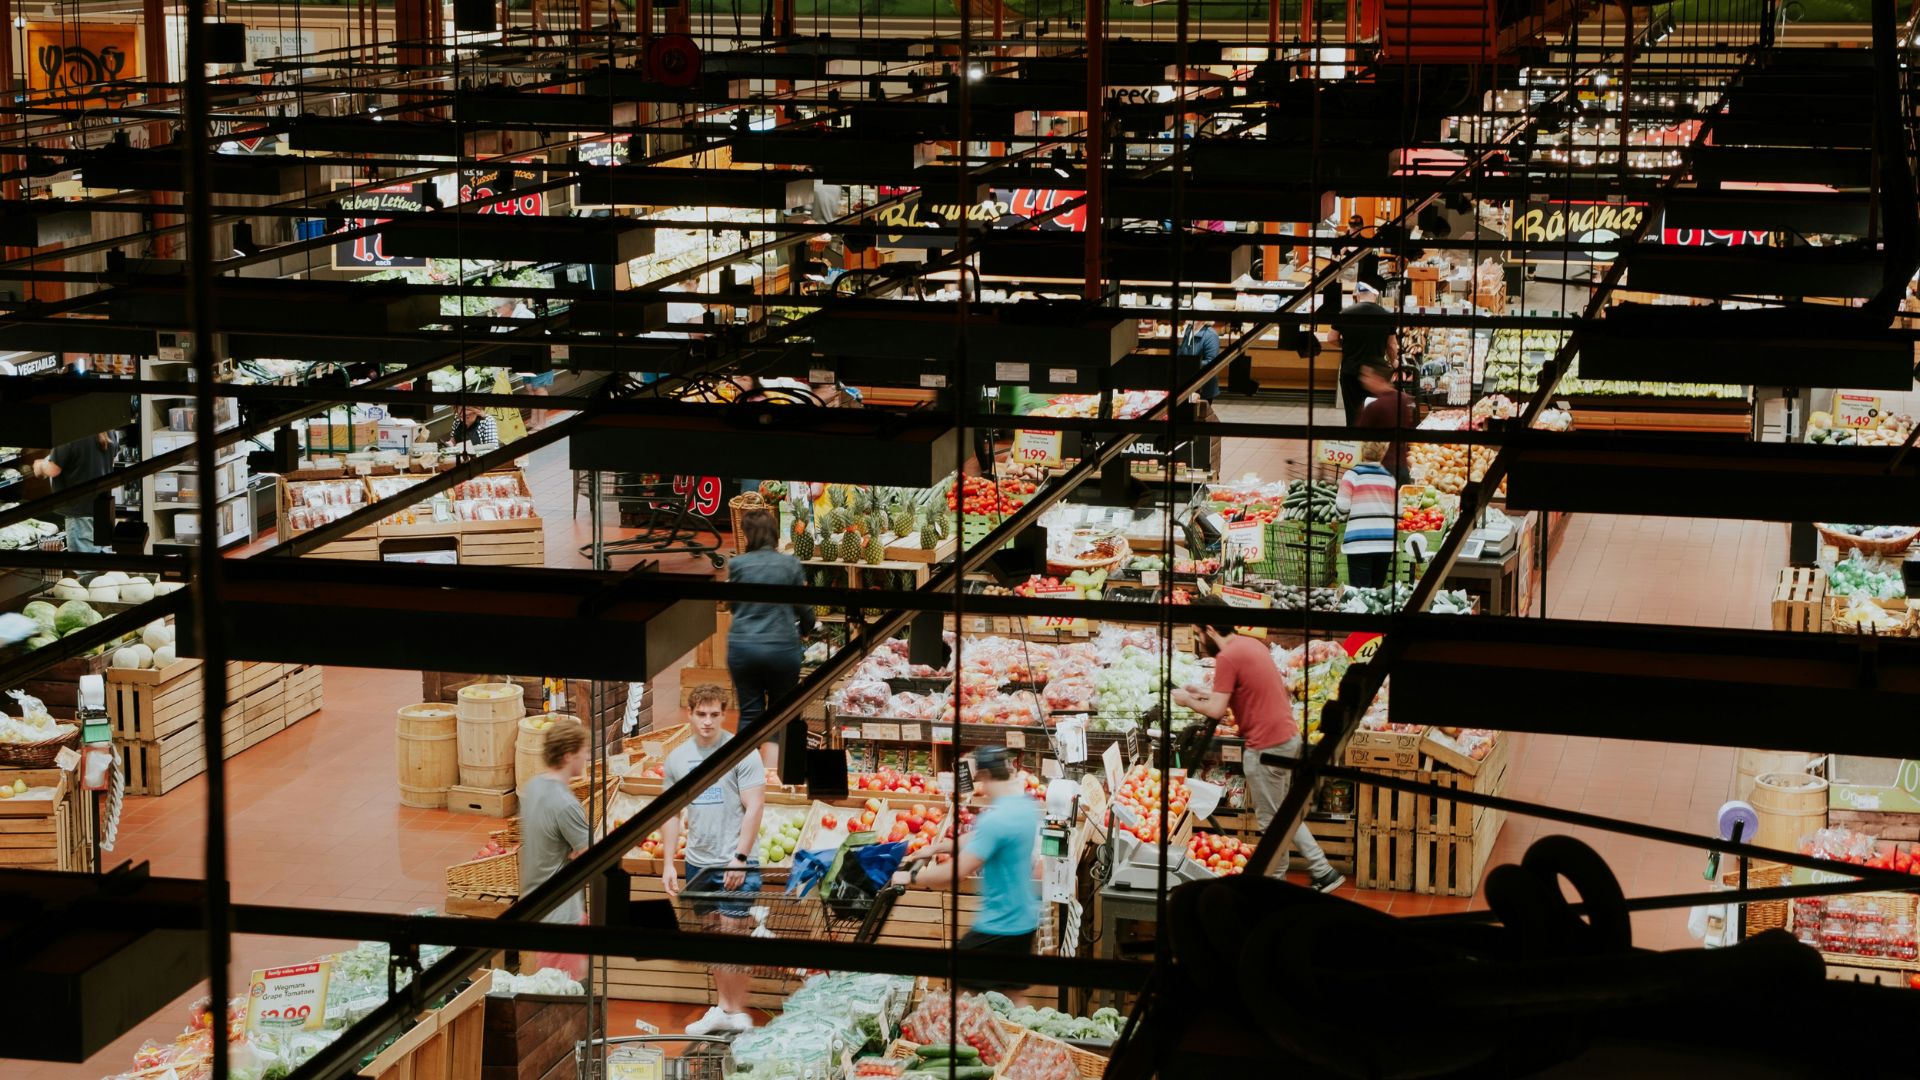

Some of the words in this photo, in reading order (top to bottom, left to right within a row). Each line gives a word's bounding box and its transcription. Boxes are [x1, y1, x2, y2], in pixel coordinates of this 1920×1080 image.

[246, 32, 277, 45] spring
[381, 193, 423, 212] Lettuce
[1513, 204, 1644, 248] Bananas
[17, 354, 57, 376] VEGETABLES
[262, 993, 283, 1001] Grape
[284, 988, 315, 997] Tomatoes
[274, 982, 306, 992] Wegmans
